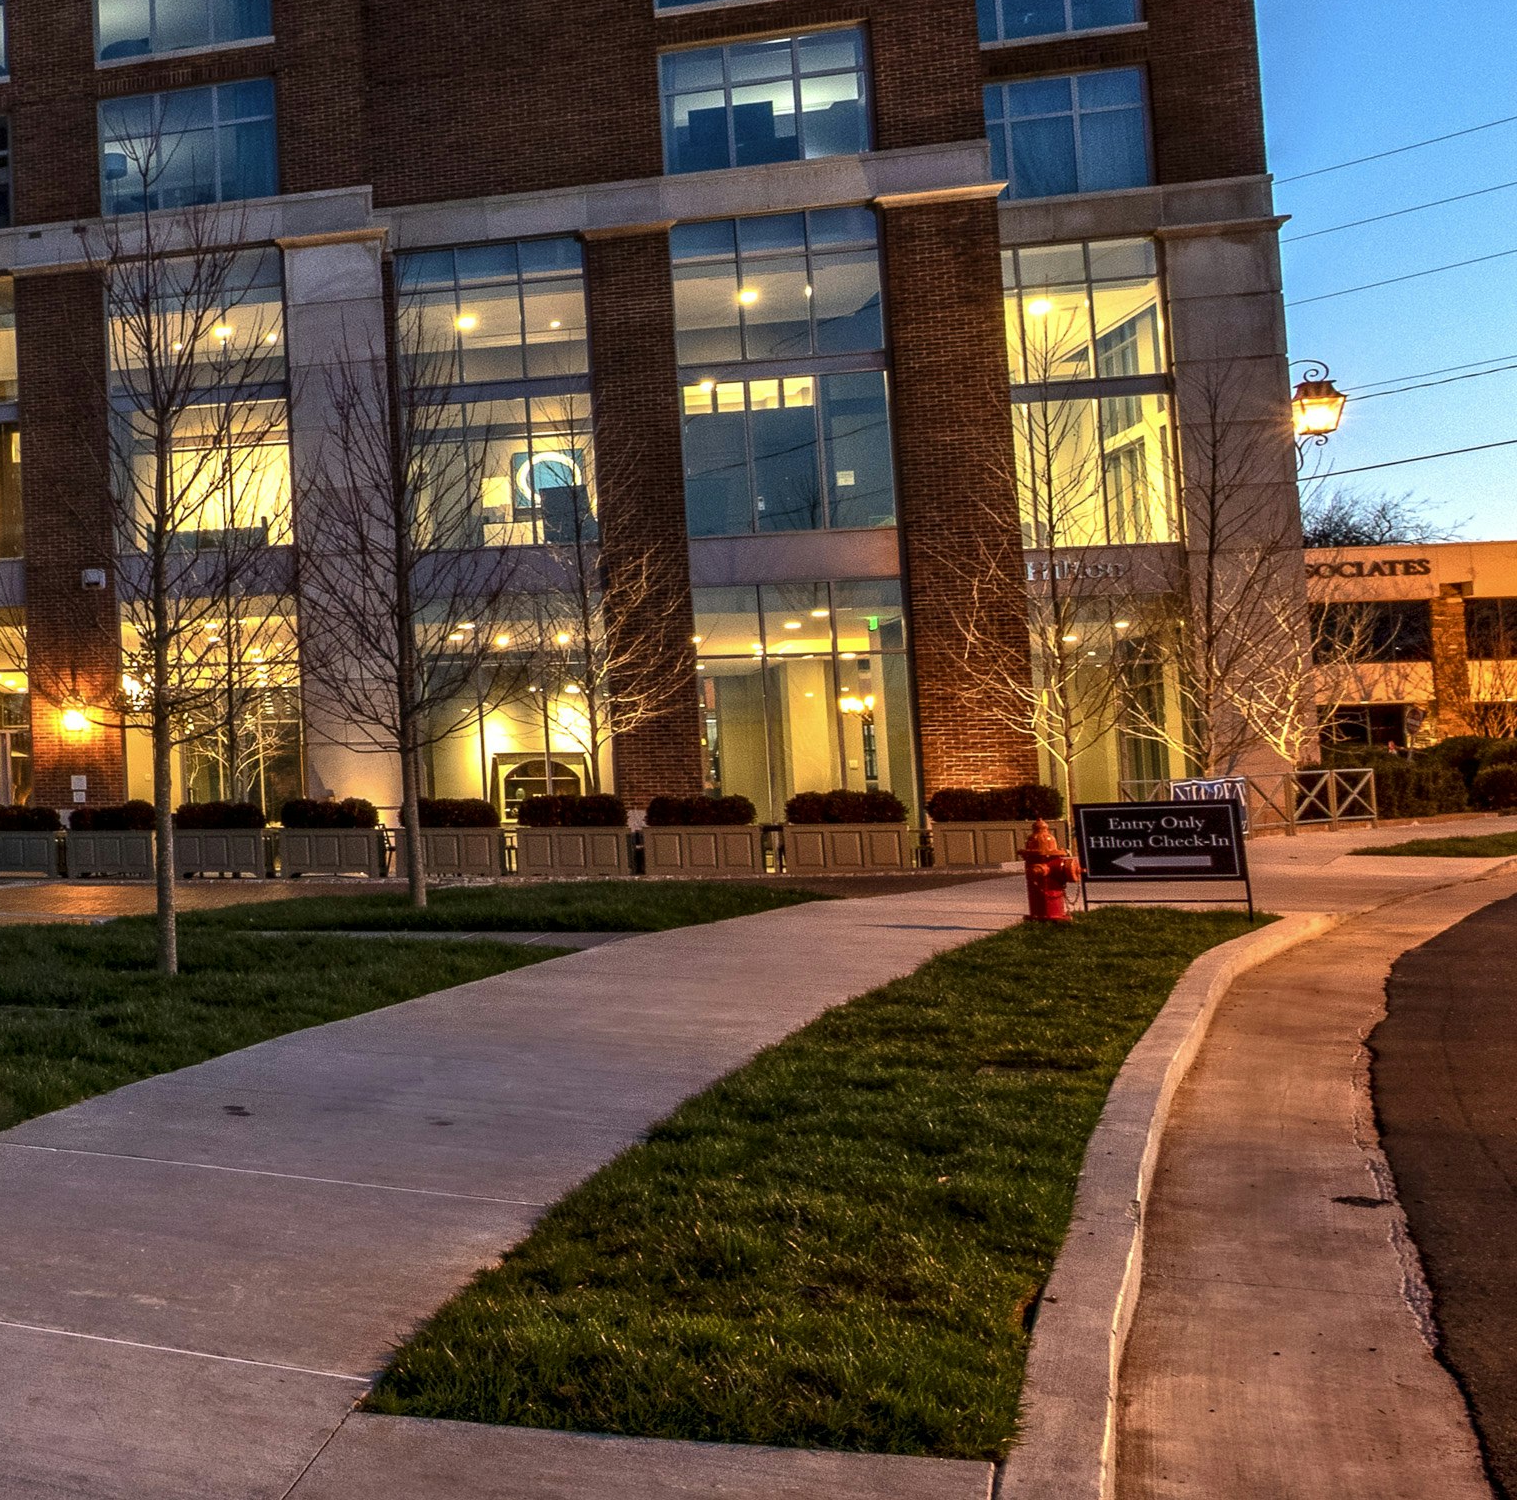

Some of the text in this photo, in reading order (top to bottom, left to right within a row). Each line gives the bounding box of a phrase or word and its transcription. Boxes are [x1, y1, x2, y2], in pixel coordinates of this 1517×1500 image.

[1108, 816, 1205, 833] Entry Only
[1089, 834, 1231, 849] Hilton Check-In
